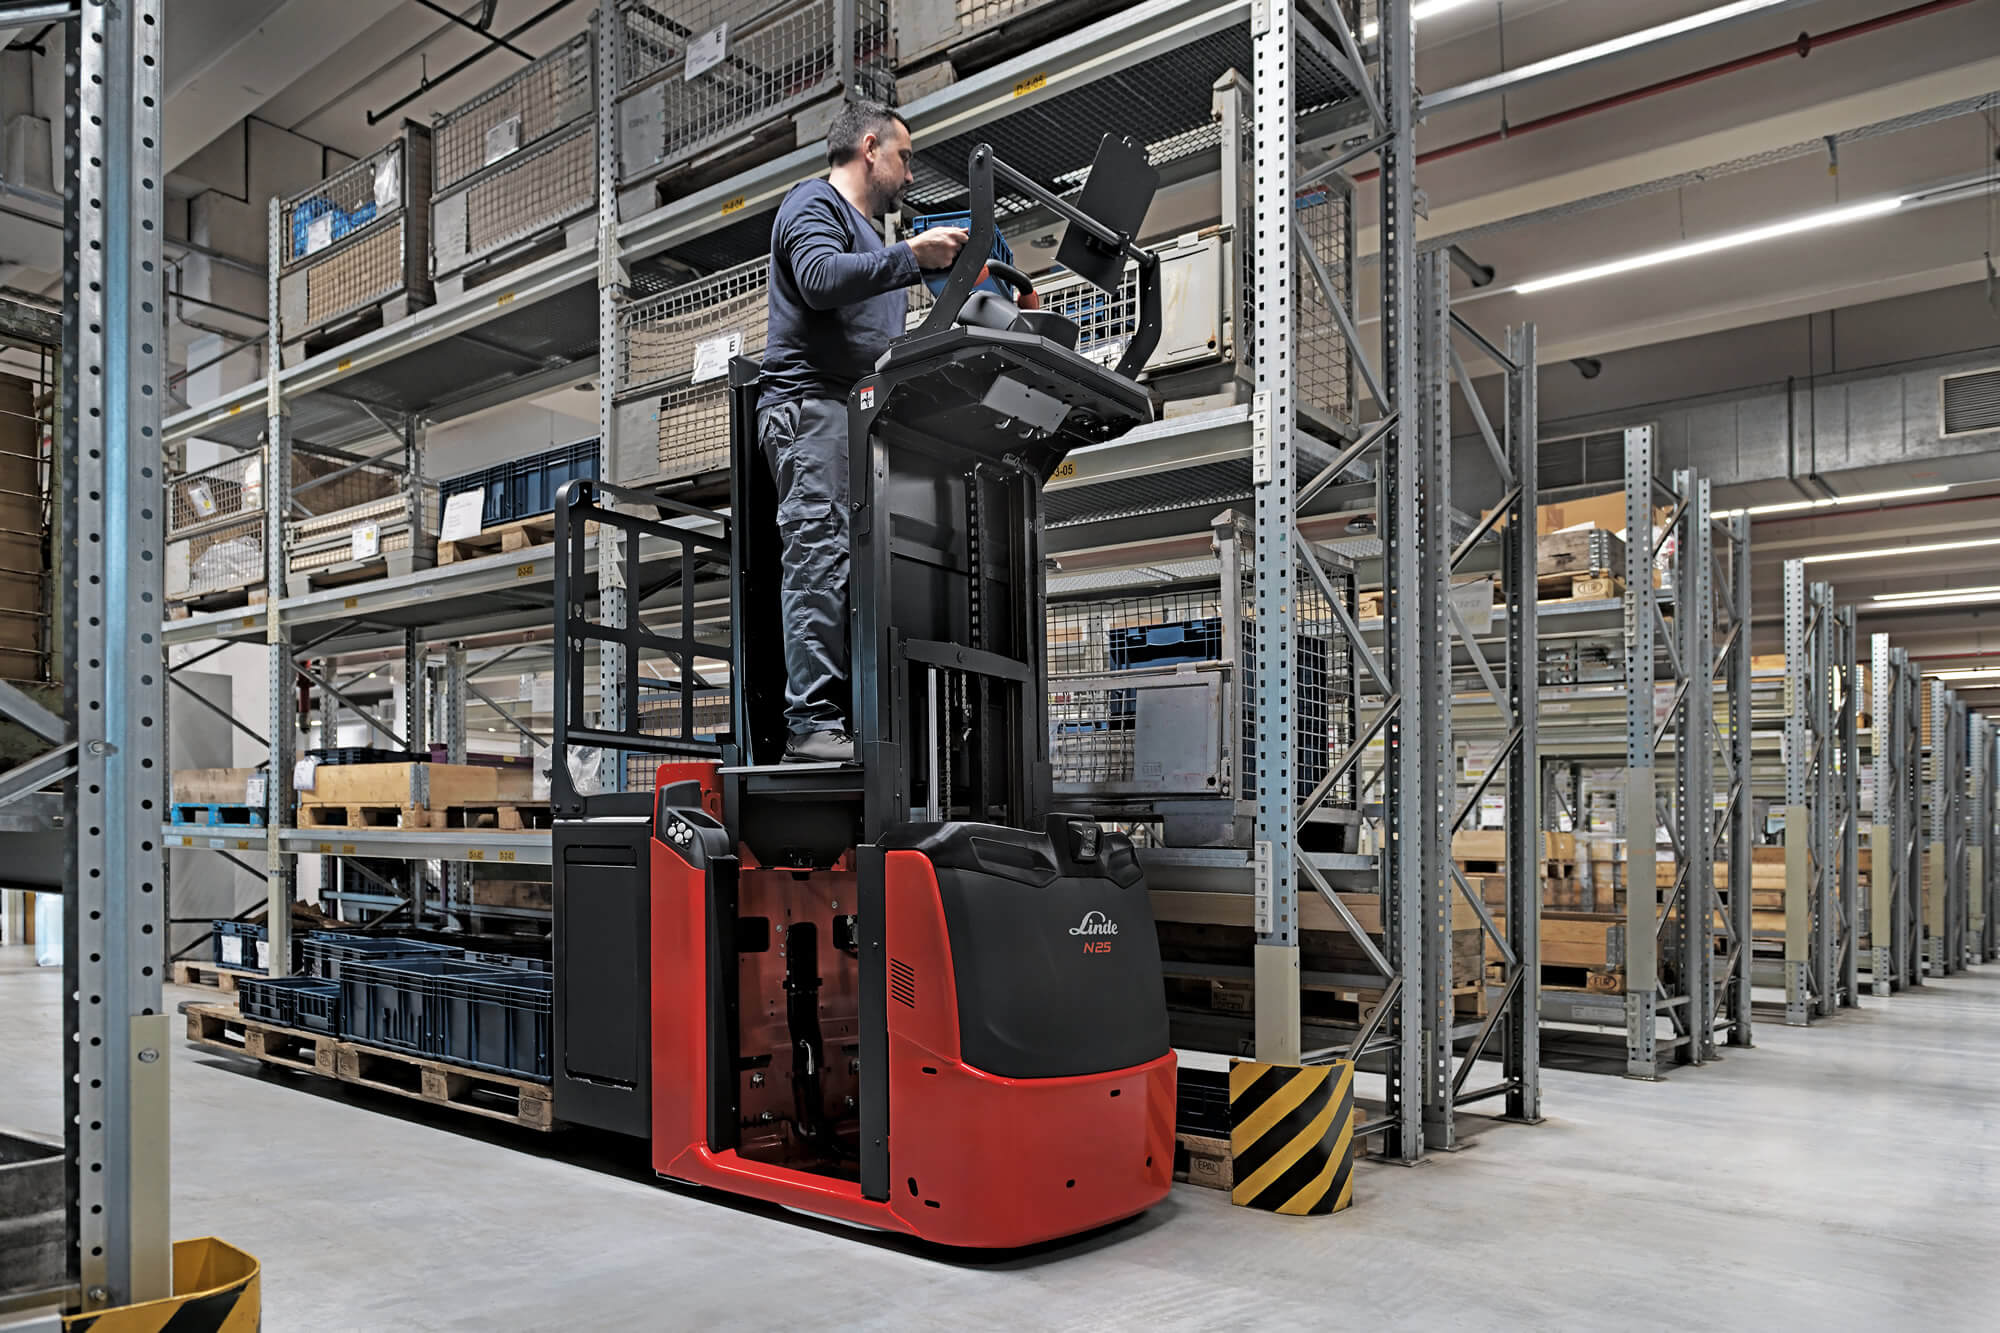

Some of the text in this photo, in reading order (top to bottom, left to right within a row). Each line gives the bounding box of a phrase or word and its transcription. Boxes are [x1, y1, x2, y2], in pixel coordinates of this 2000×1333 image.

[729, 340, 736, 352] E
[1068, 911, 1118, 935] Linde
[1083, 942, 1112, 953] N25
